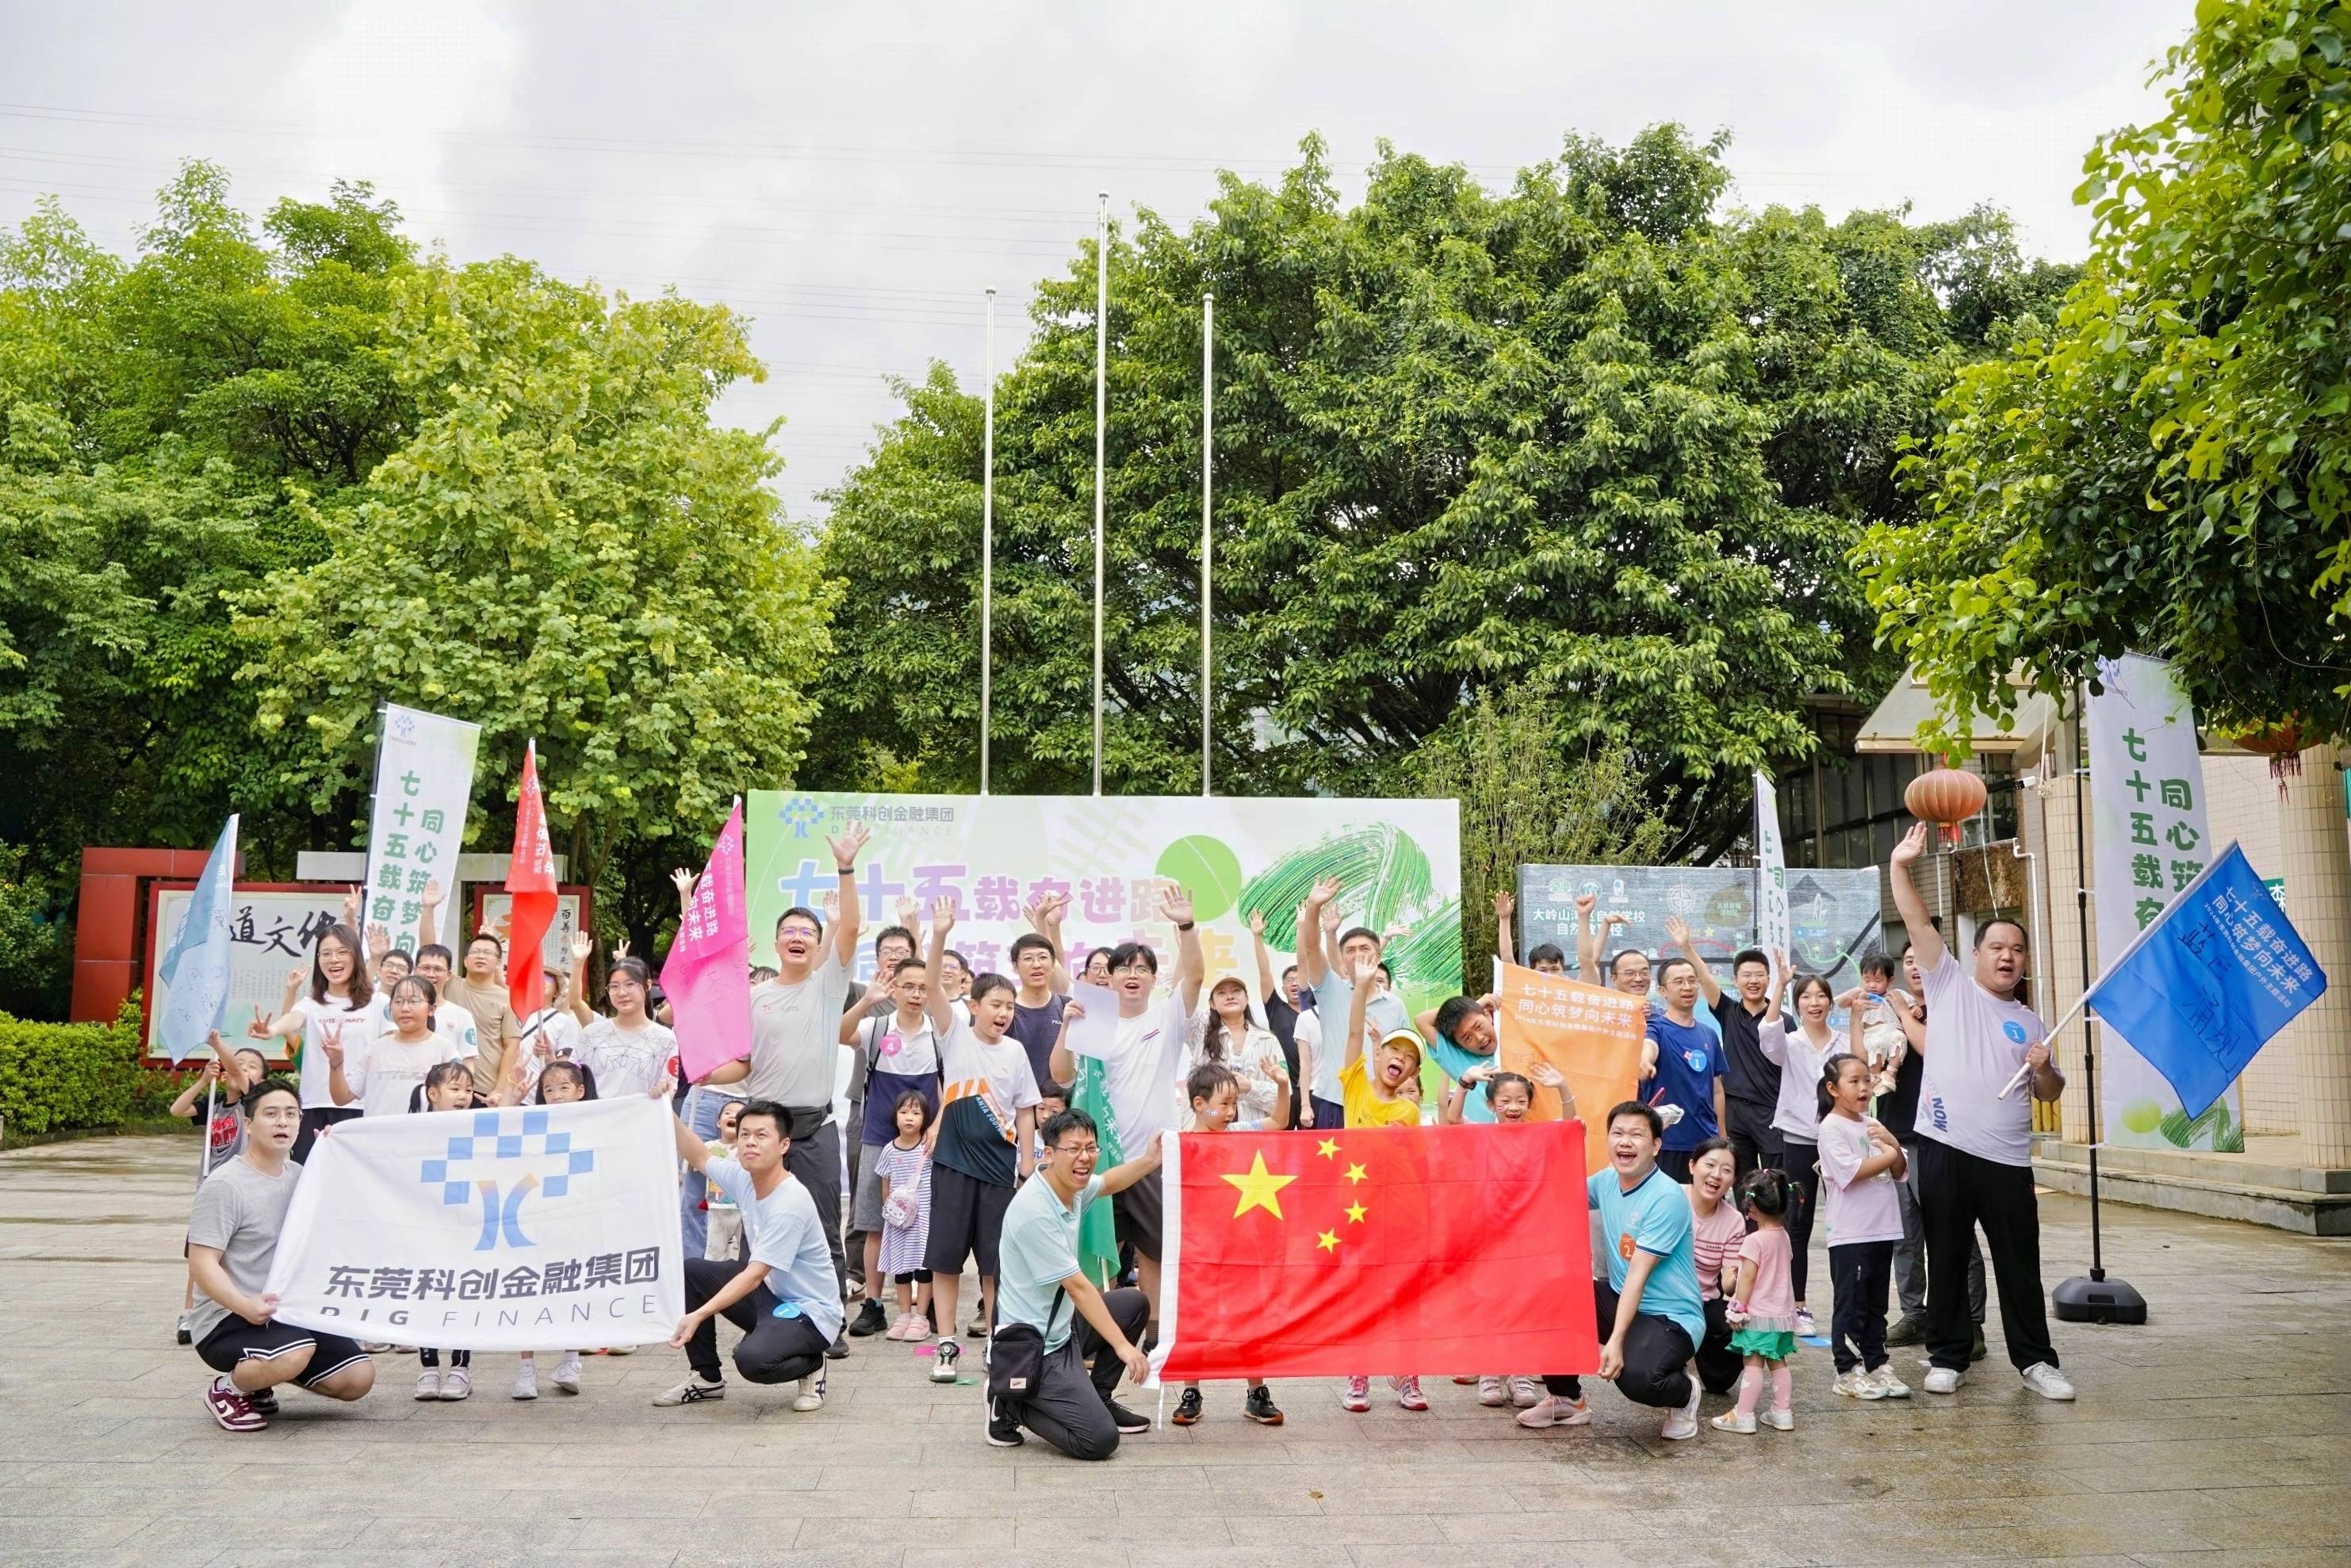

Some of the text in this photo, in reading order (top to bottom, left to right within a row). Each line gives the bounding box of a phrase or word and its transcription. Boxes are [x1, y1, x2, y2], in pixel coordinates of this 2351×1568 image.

[831, 806, 954, 821] 东莞科创金融集团
[372, 770, 421, 937] 七十五载奋
[1556, 922, 1624, 937] 自然径
[2213, 894, 2300, 994] 同心筑梦向未来
[2226, 886, 2313, 982] 七十五载奋进路
[1521, 984, 1635, 1011] 七十五载奋进路
[1518, 999, 1633, 1028] 同心筑梦向未来
[886, 1042, 894, 1053] 4
[1694, 1058, 1700, 1069] 1
[1932, 1097, 1948, 1133] NOW
[1625, 1245, 1632, 1257] 2
[323, 1246, 661, 1301] 东莞科创金融集团
[442, 1295, 657, 1327] FINANCE
